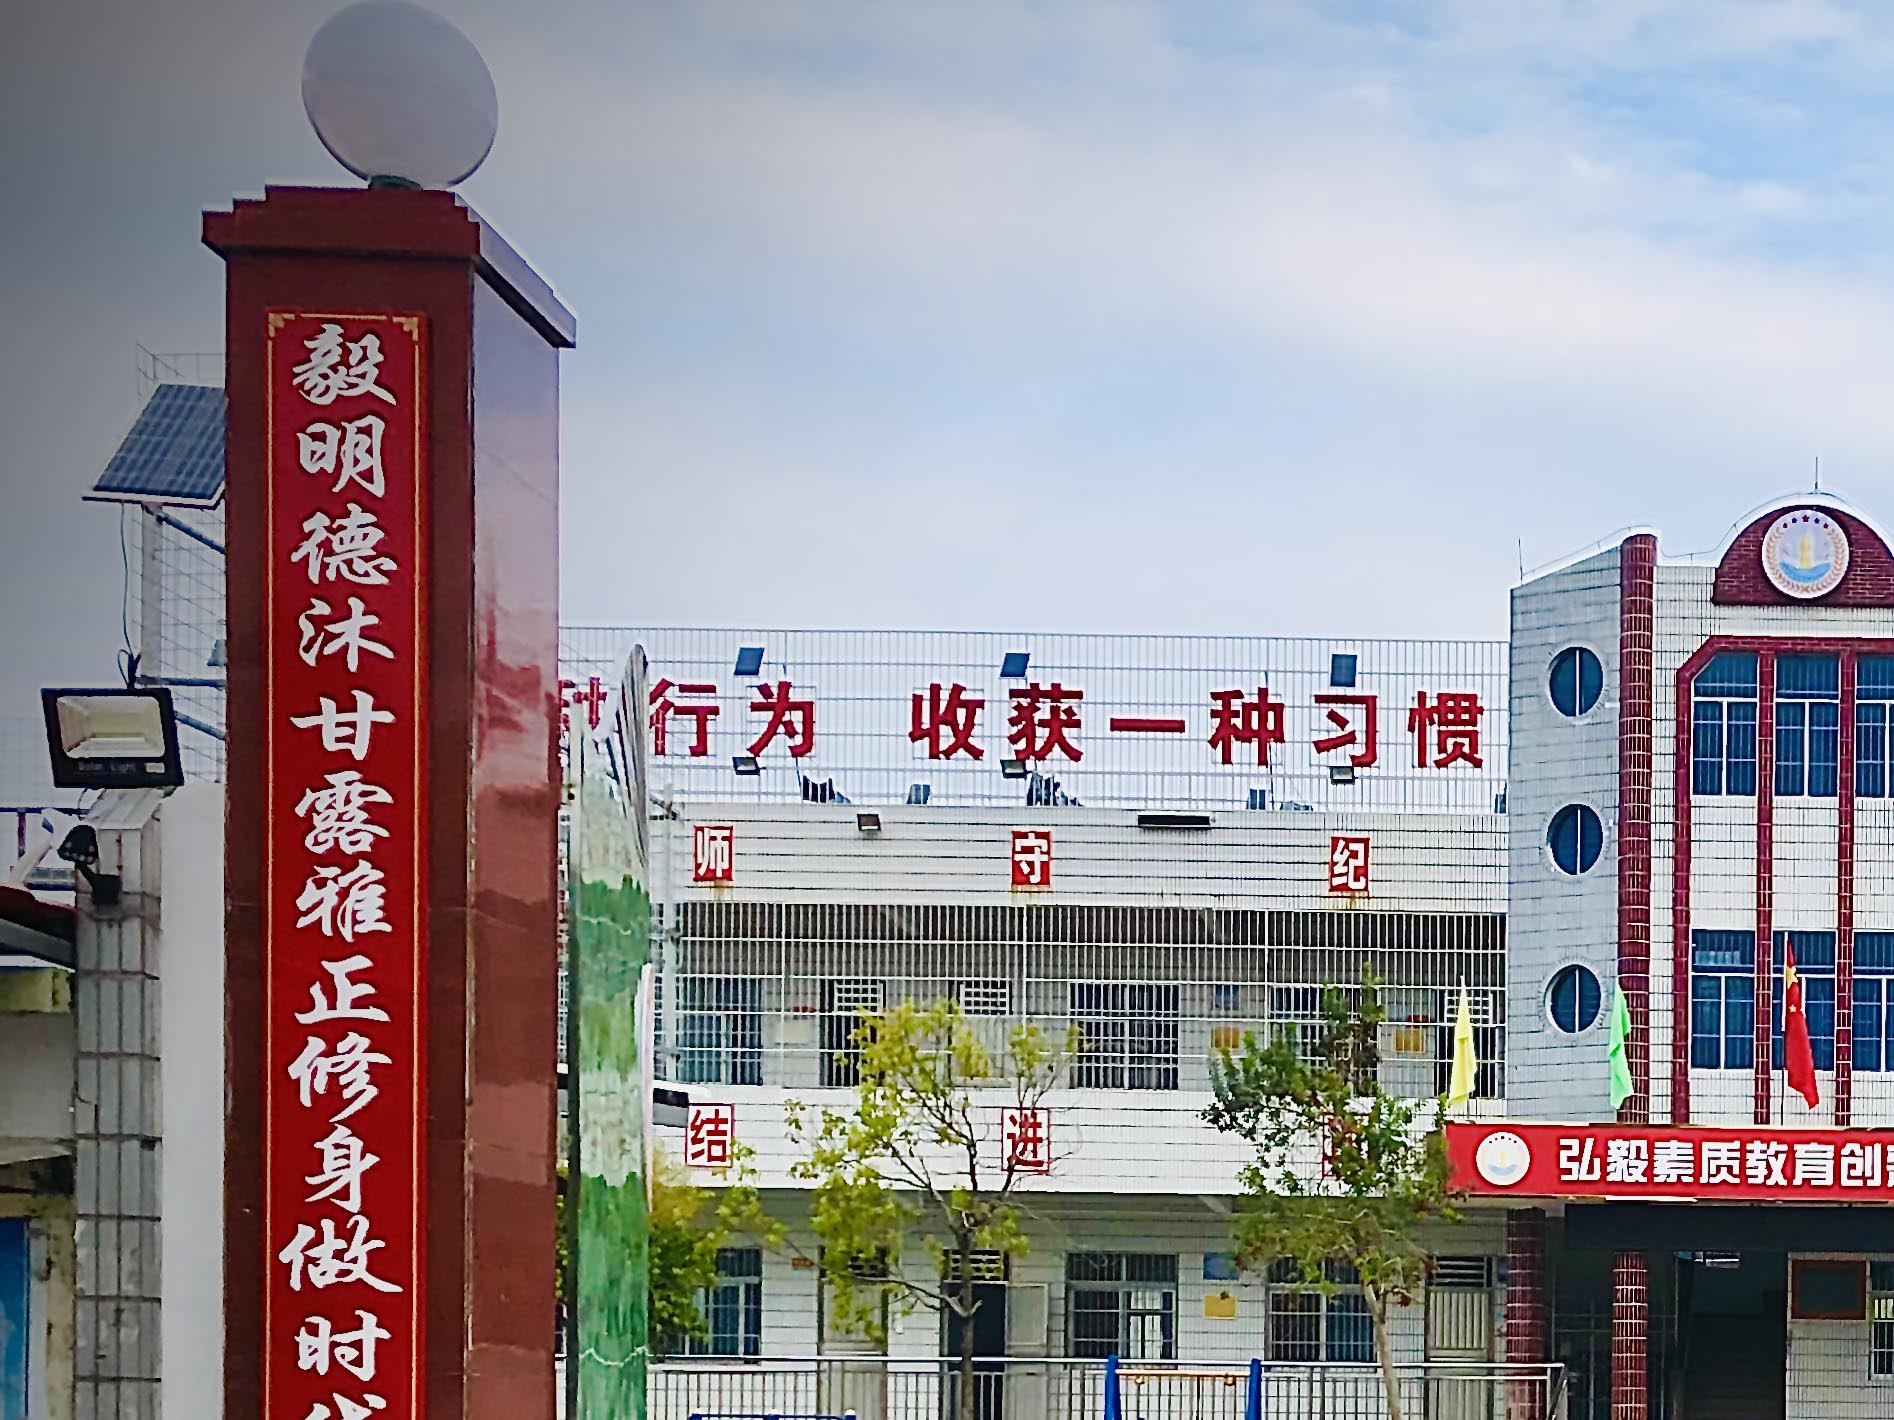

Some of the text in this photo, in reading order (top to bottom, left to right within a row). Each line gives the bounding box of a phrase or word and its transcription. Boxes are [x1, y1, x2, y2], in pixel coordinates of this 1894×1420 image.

[910, 682, 1484, 768] 收获一种习惯
[697, 829, 1367, 888] 师 守 纪
[689, 1109, 1045, 1167] 结 进
